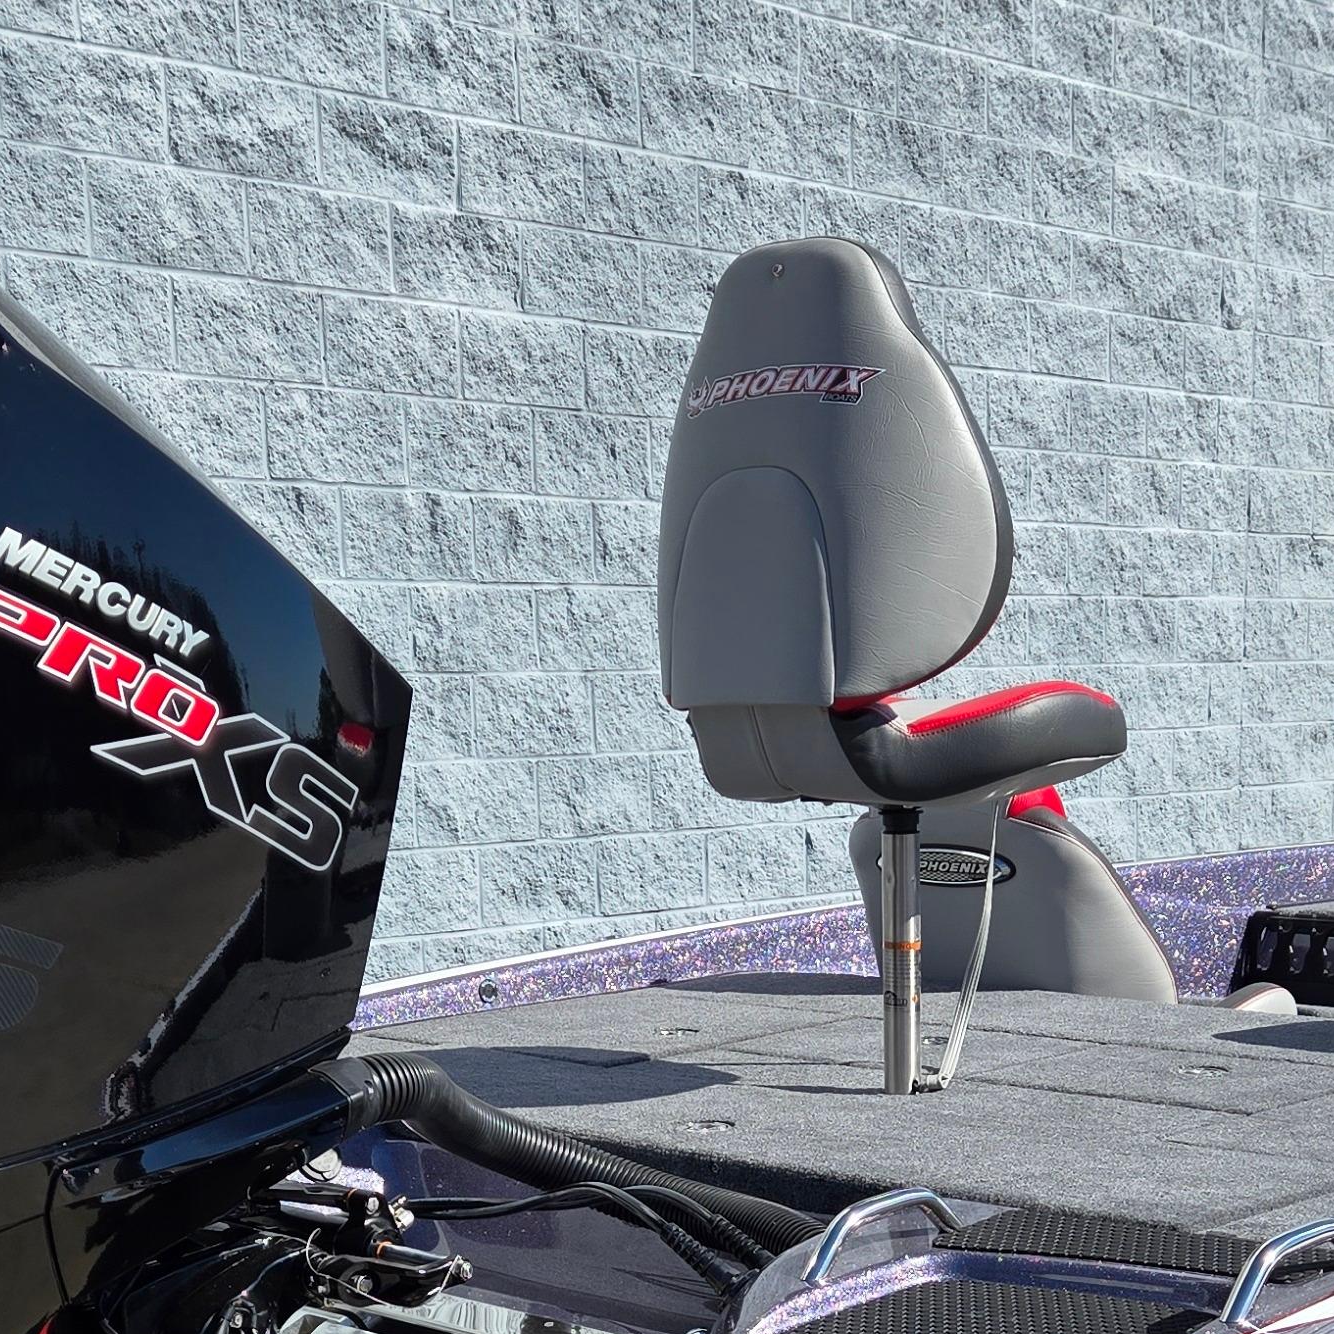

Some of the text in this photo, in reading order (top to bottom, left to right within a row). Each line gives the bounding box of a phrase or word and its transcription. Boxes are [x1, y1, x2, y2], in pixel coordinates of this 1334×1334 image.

[705, 364, 881, 408] PHOENIX
[90, 653, 359, 872] XS
[919, 861, 988, 874] PHOENIX
